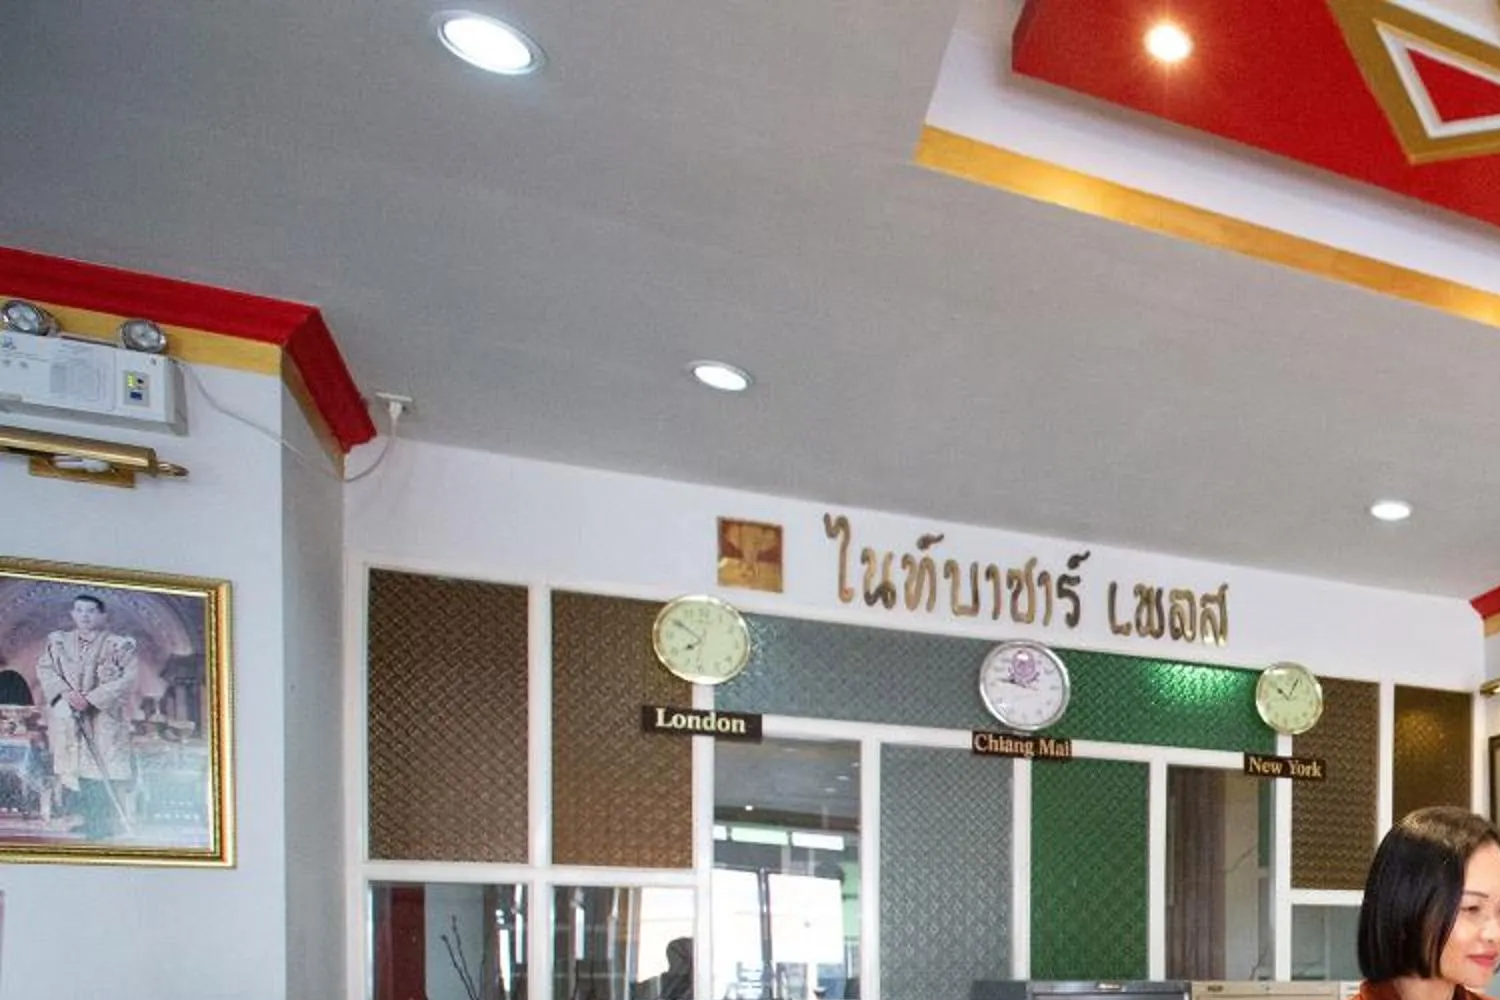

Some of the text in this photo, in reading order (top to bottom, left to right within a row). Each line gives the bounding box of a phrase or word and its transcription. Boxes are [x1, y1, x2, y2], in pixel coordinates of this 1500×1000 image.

[655, 707, 747, 734] London
[973, 733, 1071, 758] Chiang Mai
[1248, 756, 1323, 778] New York
